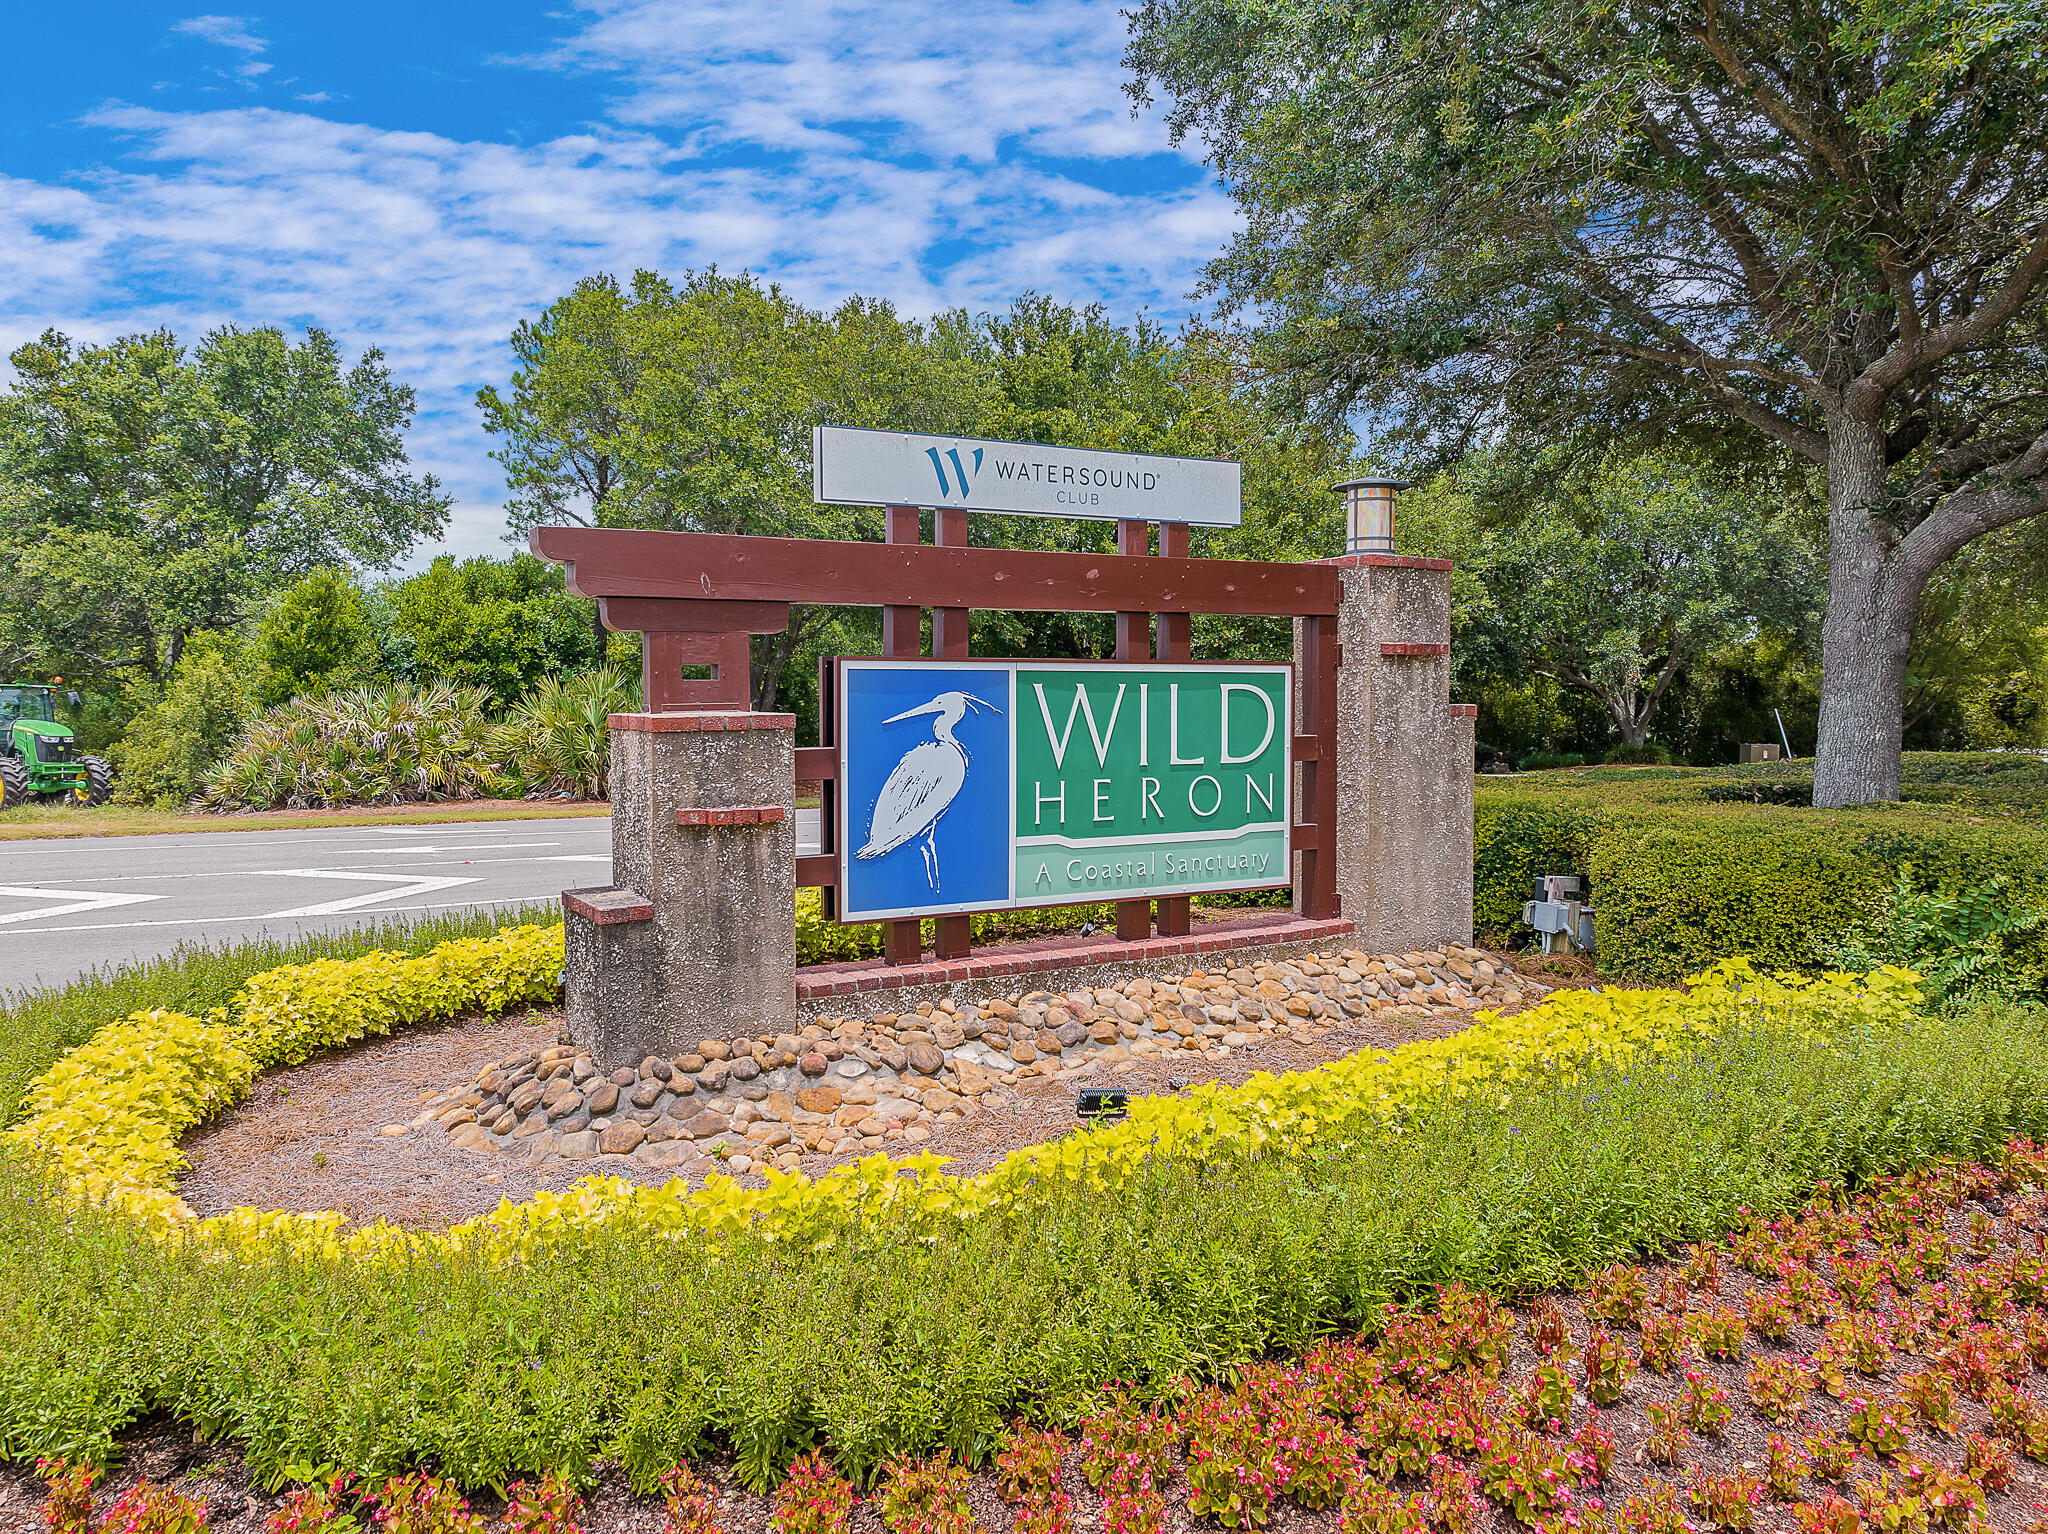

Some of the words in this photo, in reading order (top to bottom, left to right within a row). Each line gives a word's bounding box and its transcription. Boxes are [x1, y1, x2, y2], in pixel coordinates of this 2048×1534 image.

[1056, 490, 1101, 506] CLUB
[1033, 683, 1276, 770] WILD
[1034, 773, 1274, 825] HERON
[1035, 862, 1052, 884] A
[1066, 852, 1155, 881] Coastal
[1165, 852, 1270, 878] Sanctuary
